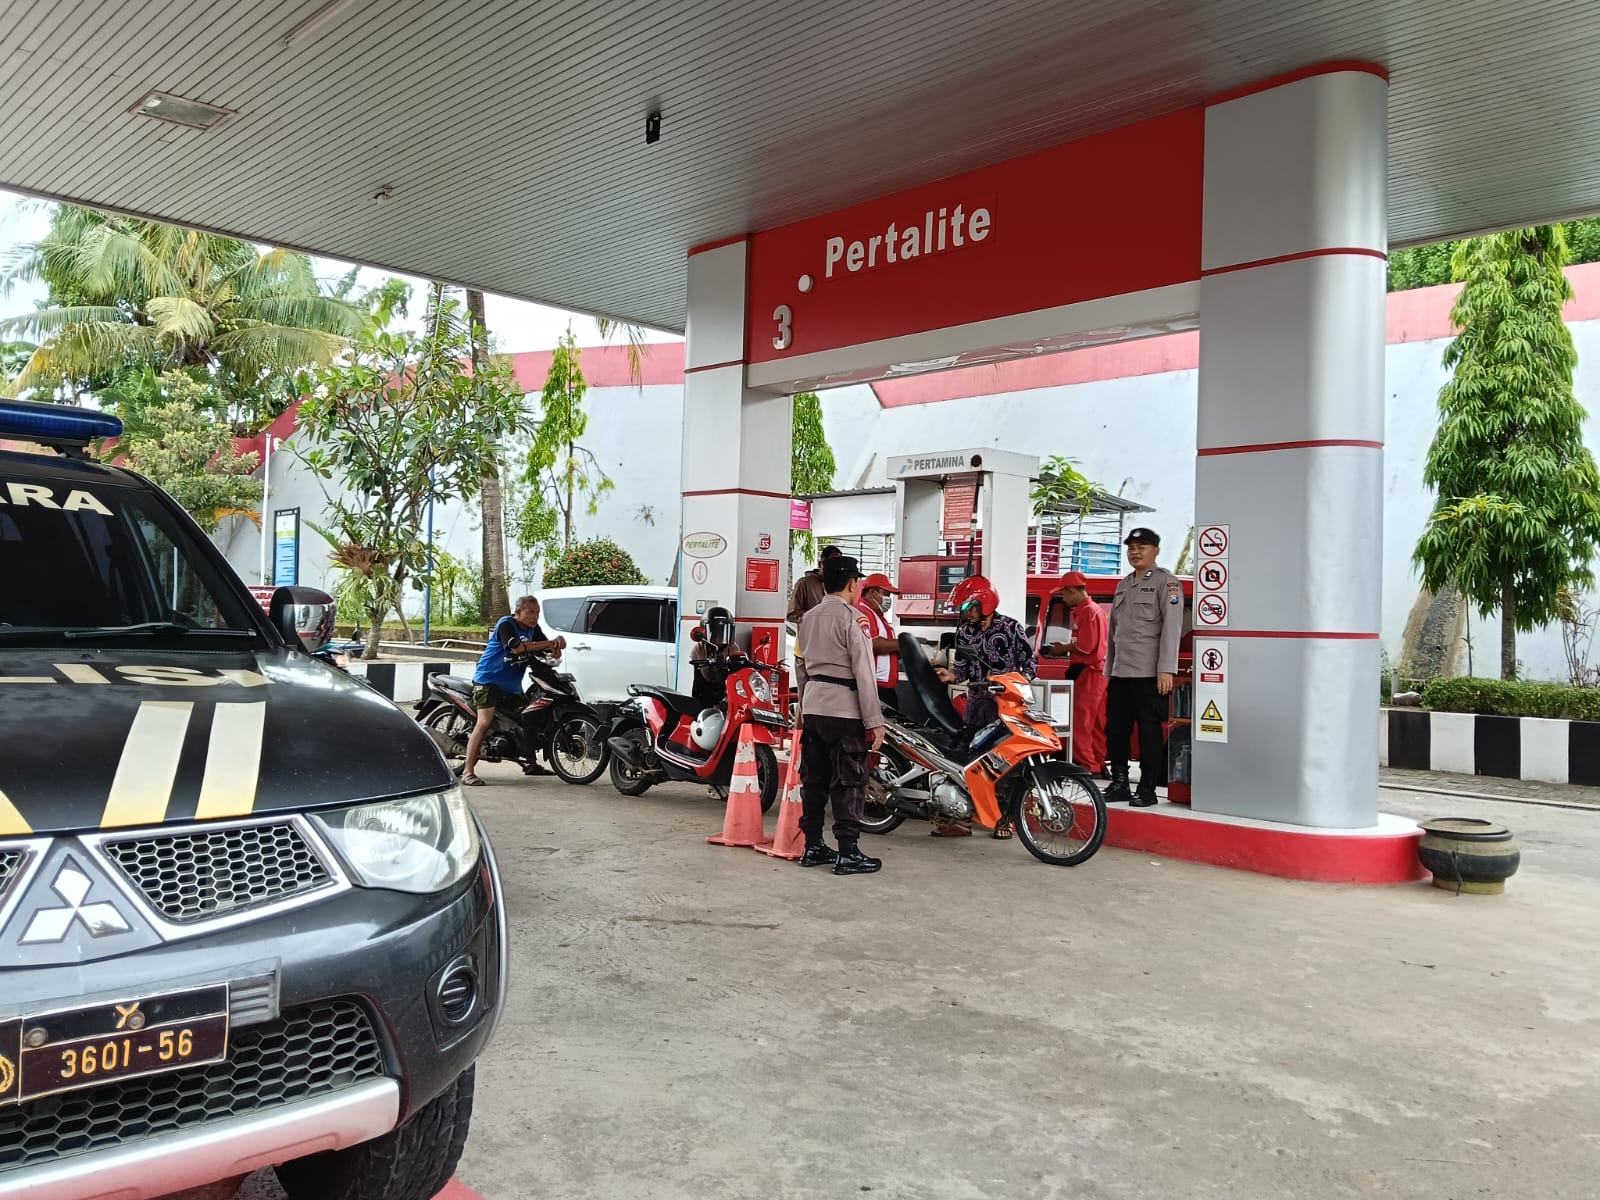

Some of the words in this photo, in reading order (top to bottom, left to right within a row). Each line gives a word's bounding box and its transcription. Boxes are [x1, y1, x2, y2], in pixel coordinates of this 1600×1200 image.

[826, 203, 991, 278] Pertalite
[772, 304, 793, 350] 3
[914, 456, 965, 471] PERTAMINA
[0, 482, 115, 516] RA
[685, 540, 720, 549] PERTALITE
[60, 1029, 194, 1079] 3601-56
